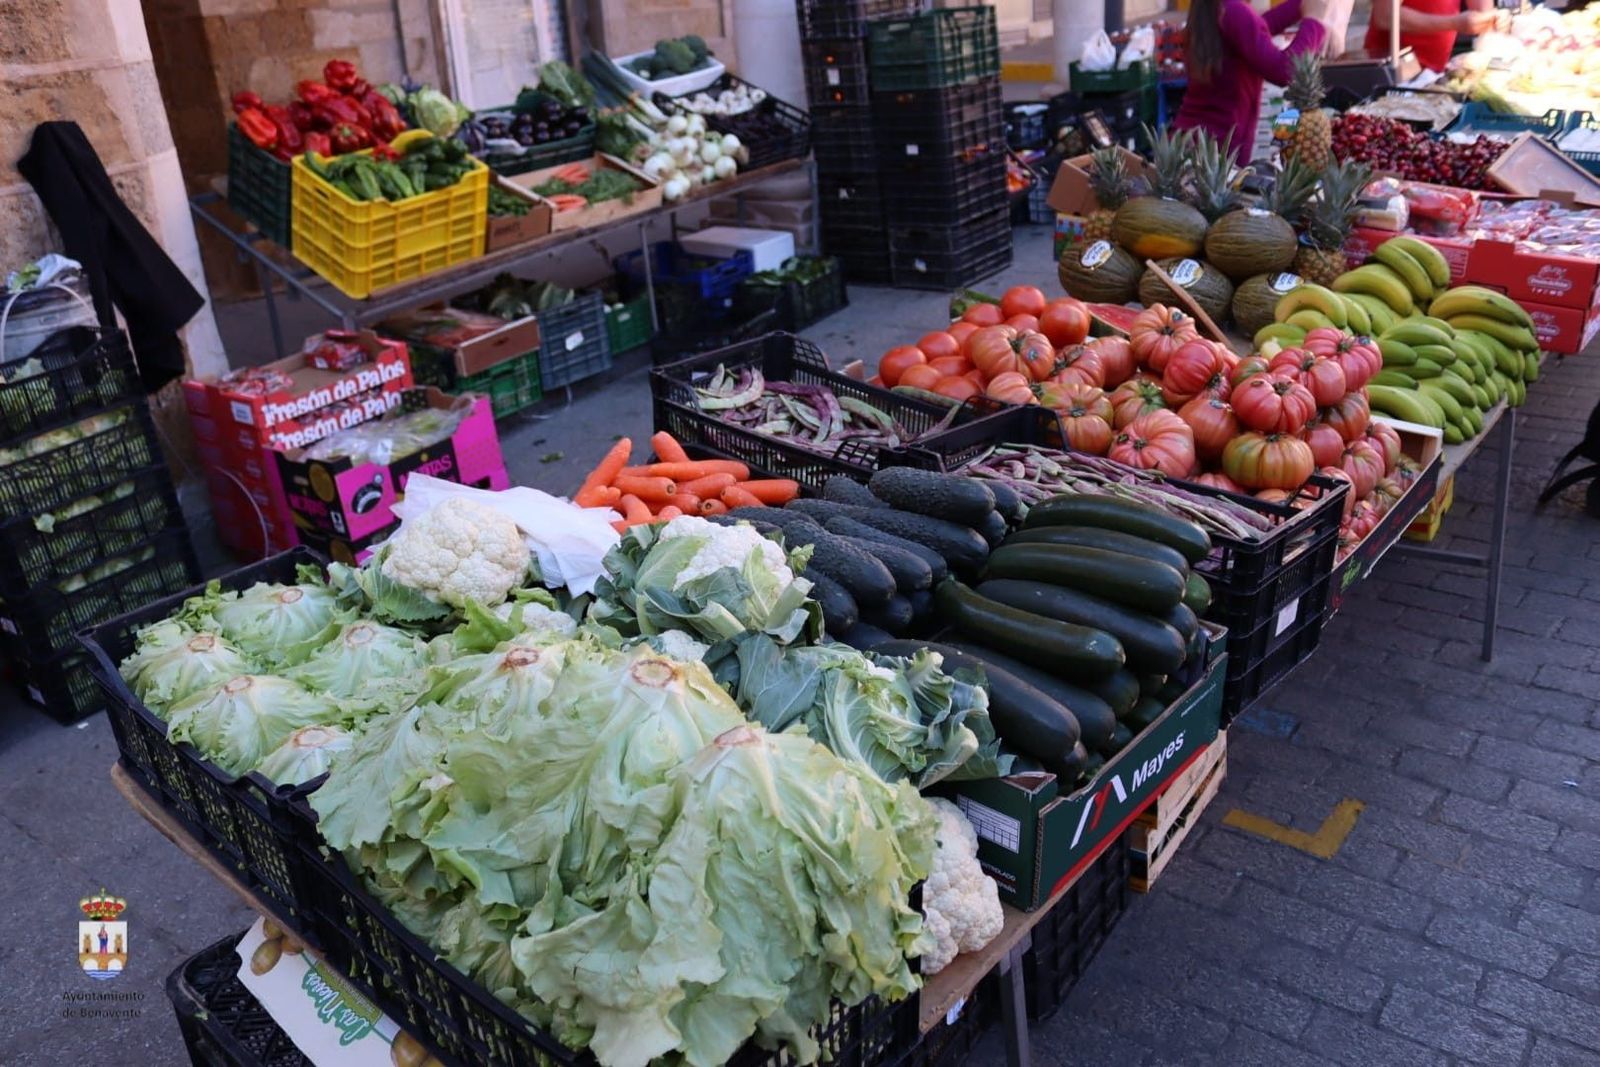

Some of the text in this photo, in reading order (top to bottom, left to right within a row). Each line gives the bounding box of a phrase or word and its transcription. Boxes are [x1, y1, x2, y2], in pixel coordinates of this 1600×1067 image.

[261, 388, 332, 428] Fresón
[333, 379, 357, 400] de
[356, 360, 406, 391] Palos
[339, 408, 363, 429] de
[362, 391, 402, 421] Palo
[1132, 732, 1184, 792] Mayes
[340, 1008, 369, 1040] Las
